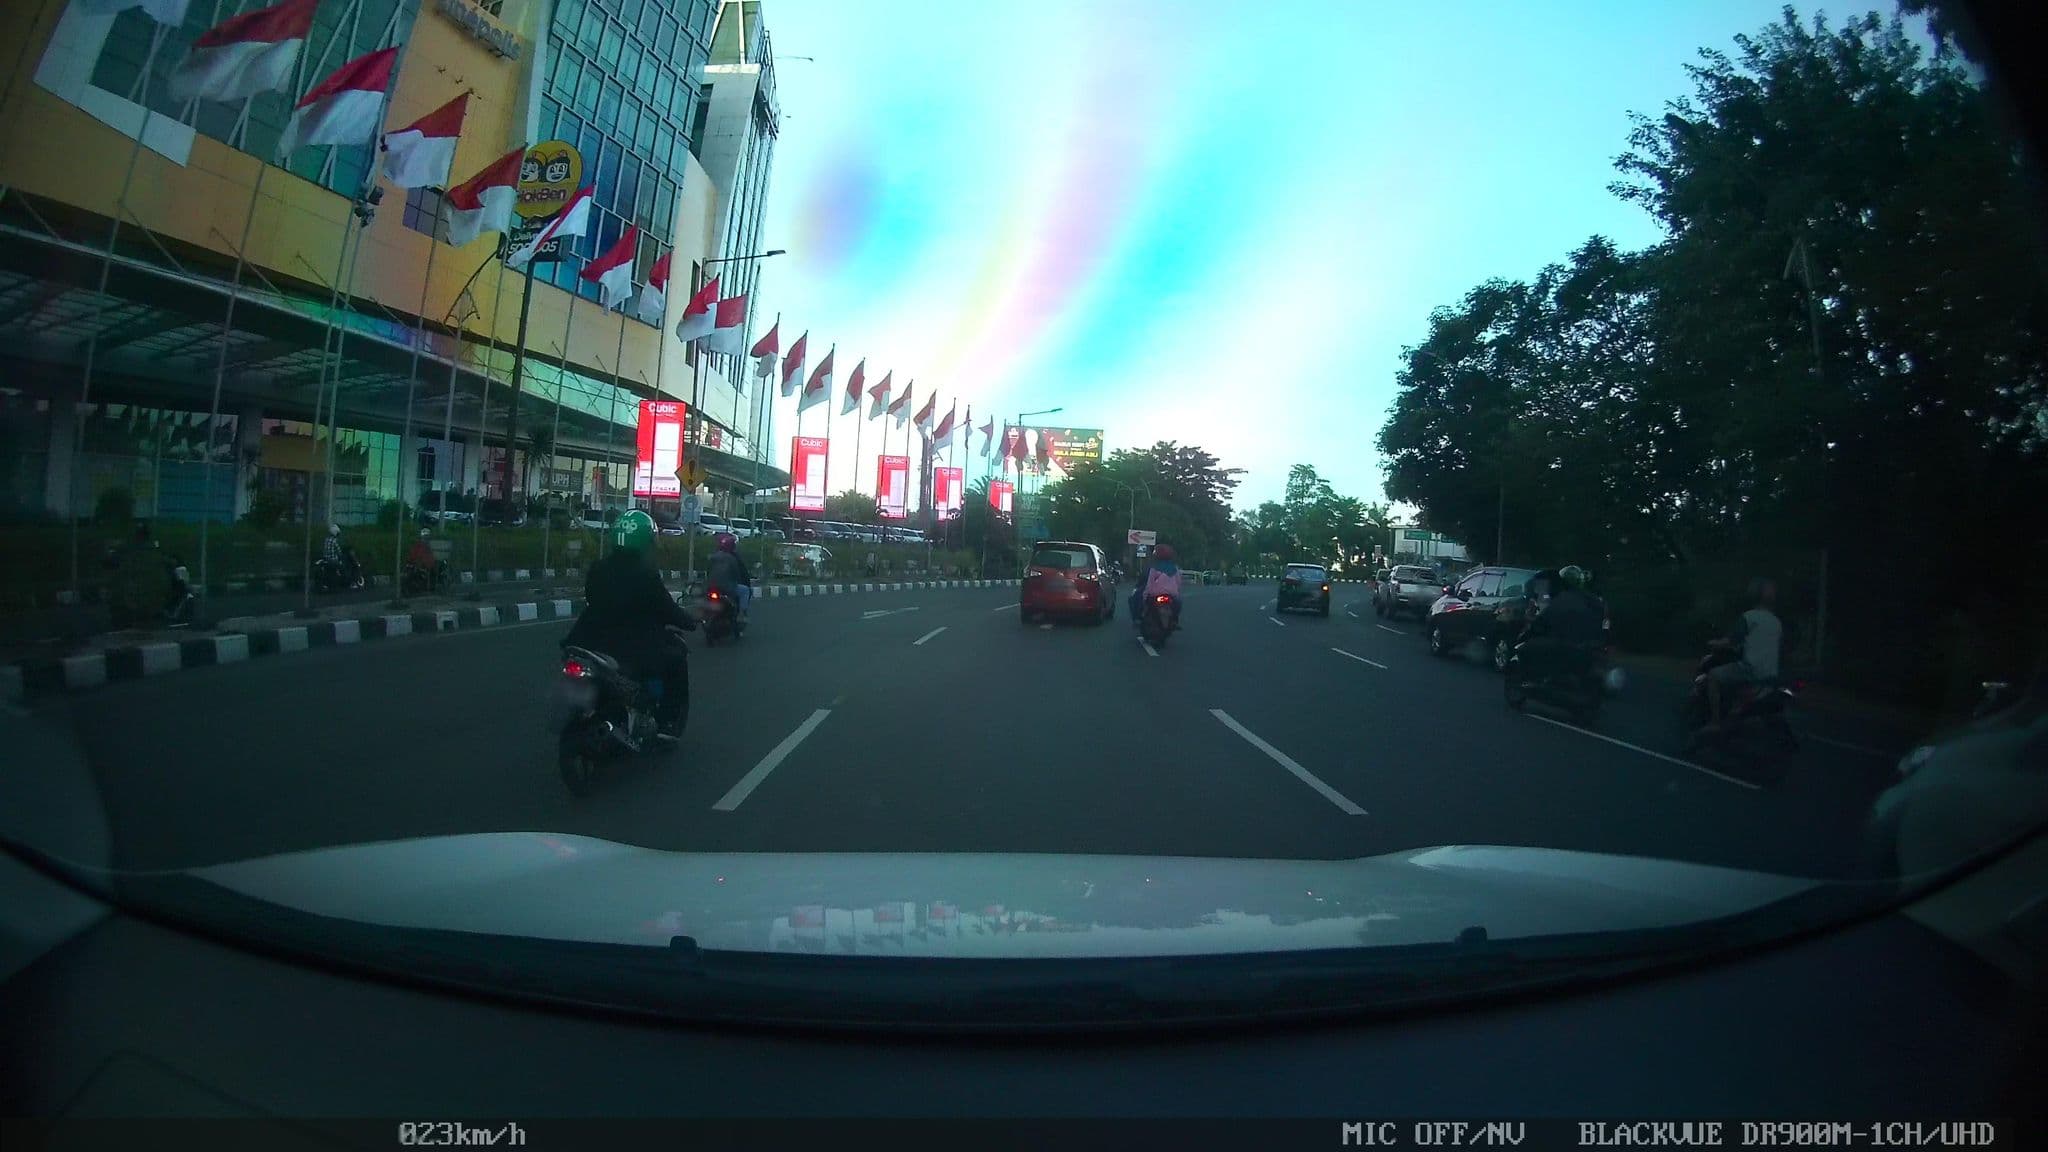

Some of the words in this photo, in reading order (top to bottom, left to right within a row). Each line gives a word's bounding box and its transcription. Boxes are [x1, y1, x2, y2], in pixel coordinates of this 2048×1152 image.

[648, 402, 678, 414] Cubic
[801, 438, 823, 448] Cubic
[884, 456, 905, 464] Cubic
